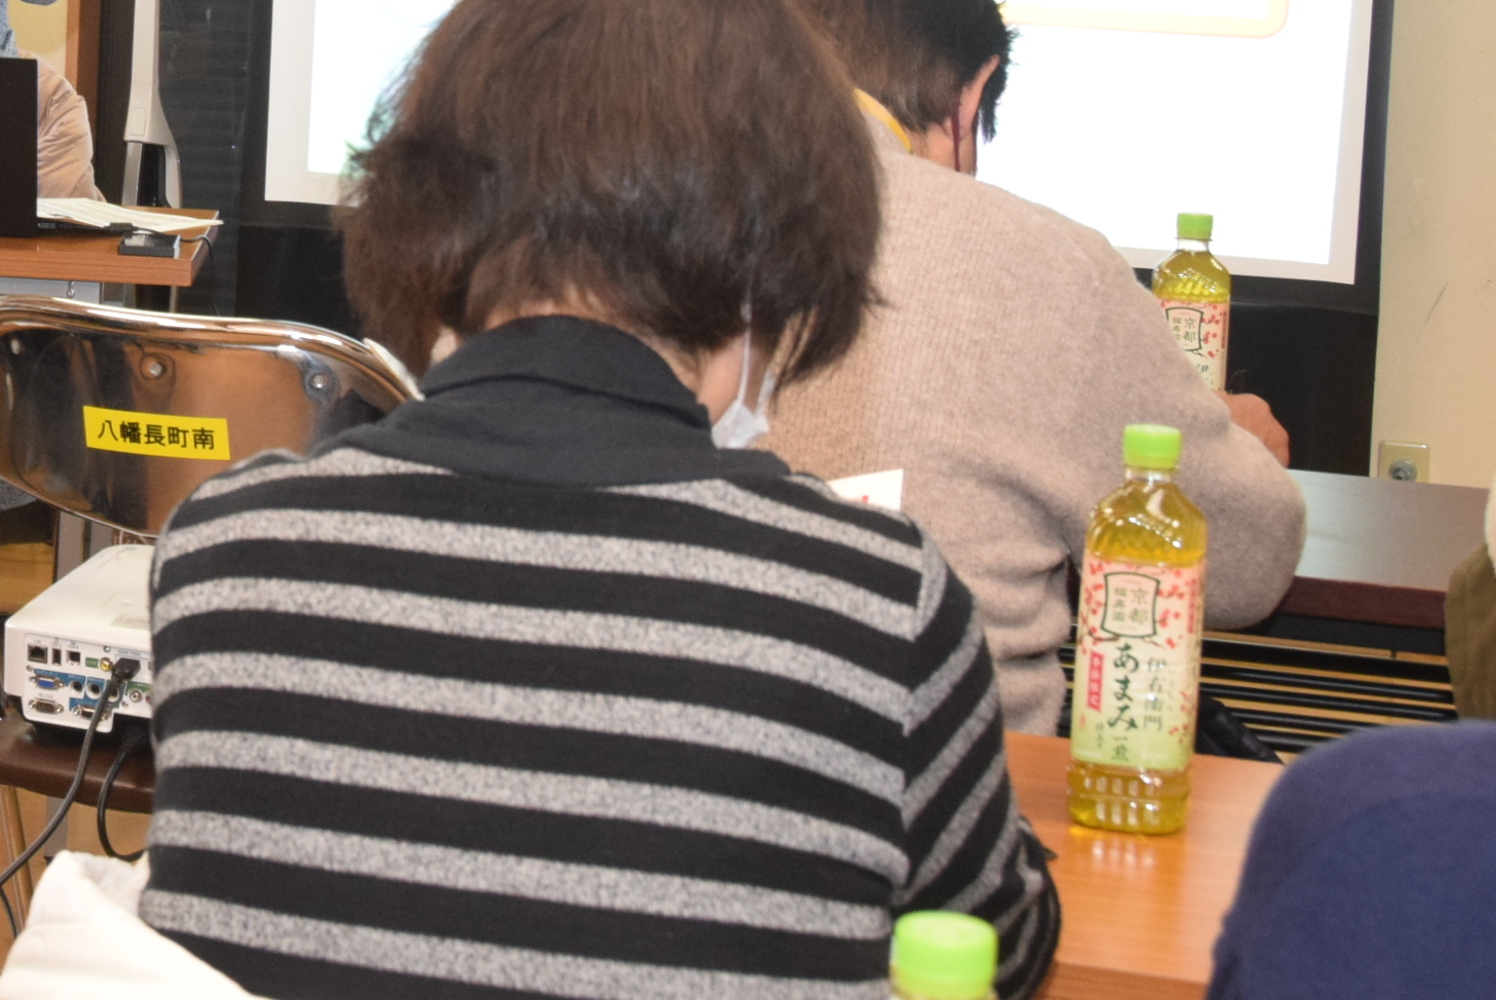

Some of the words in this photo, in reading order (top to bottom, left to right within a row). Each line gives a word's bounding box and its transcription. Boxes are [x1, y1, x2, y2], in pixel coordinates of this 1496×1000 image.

[1182, 317, 1196, 343] 京都
[98, 419, 214, 450] 八幡長町南
[1129, 587, 1149, 624] 京都
